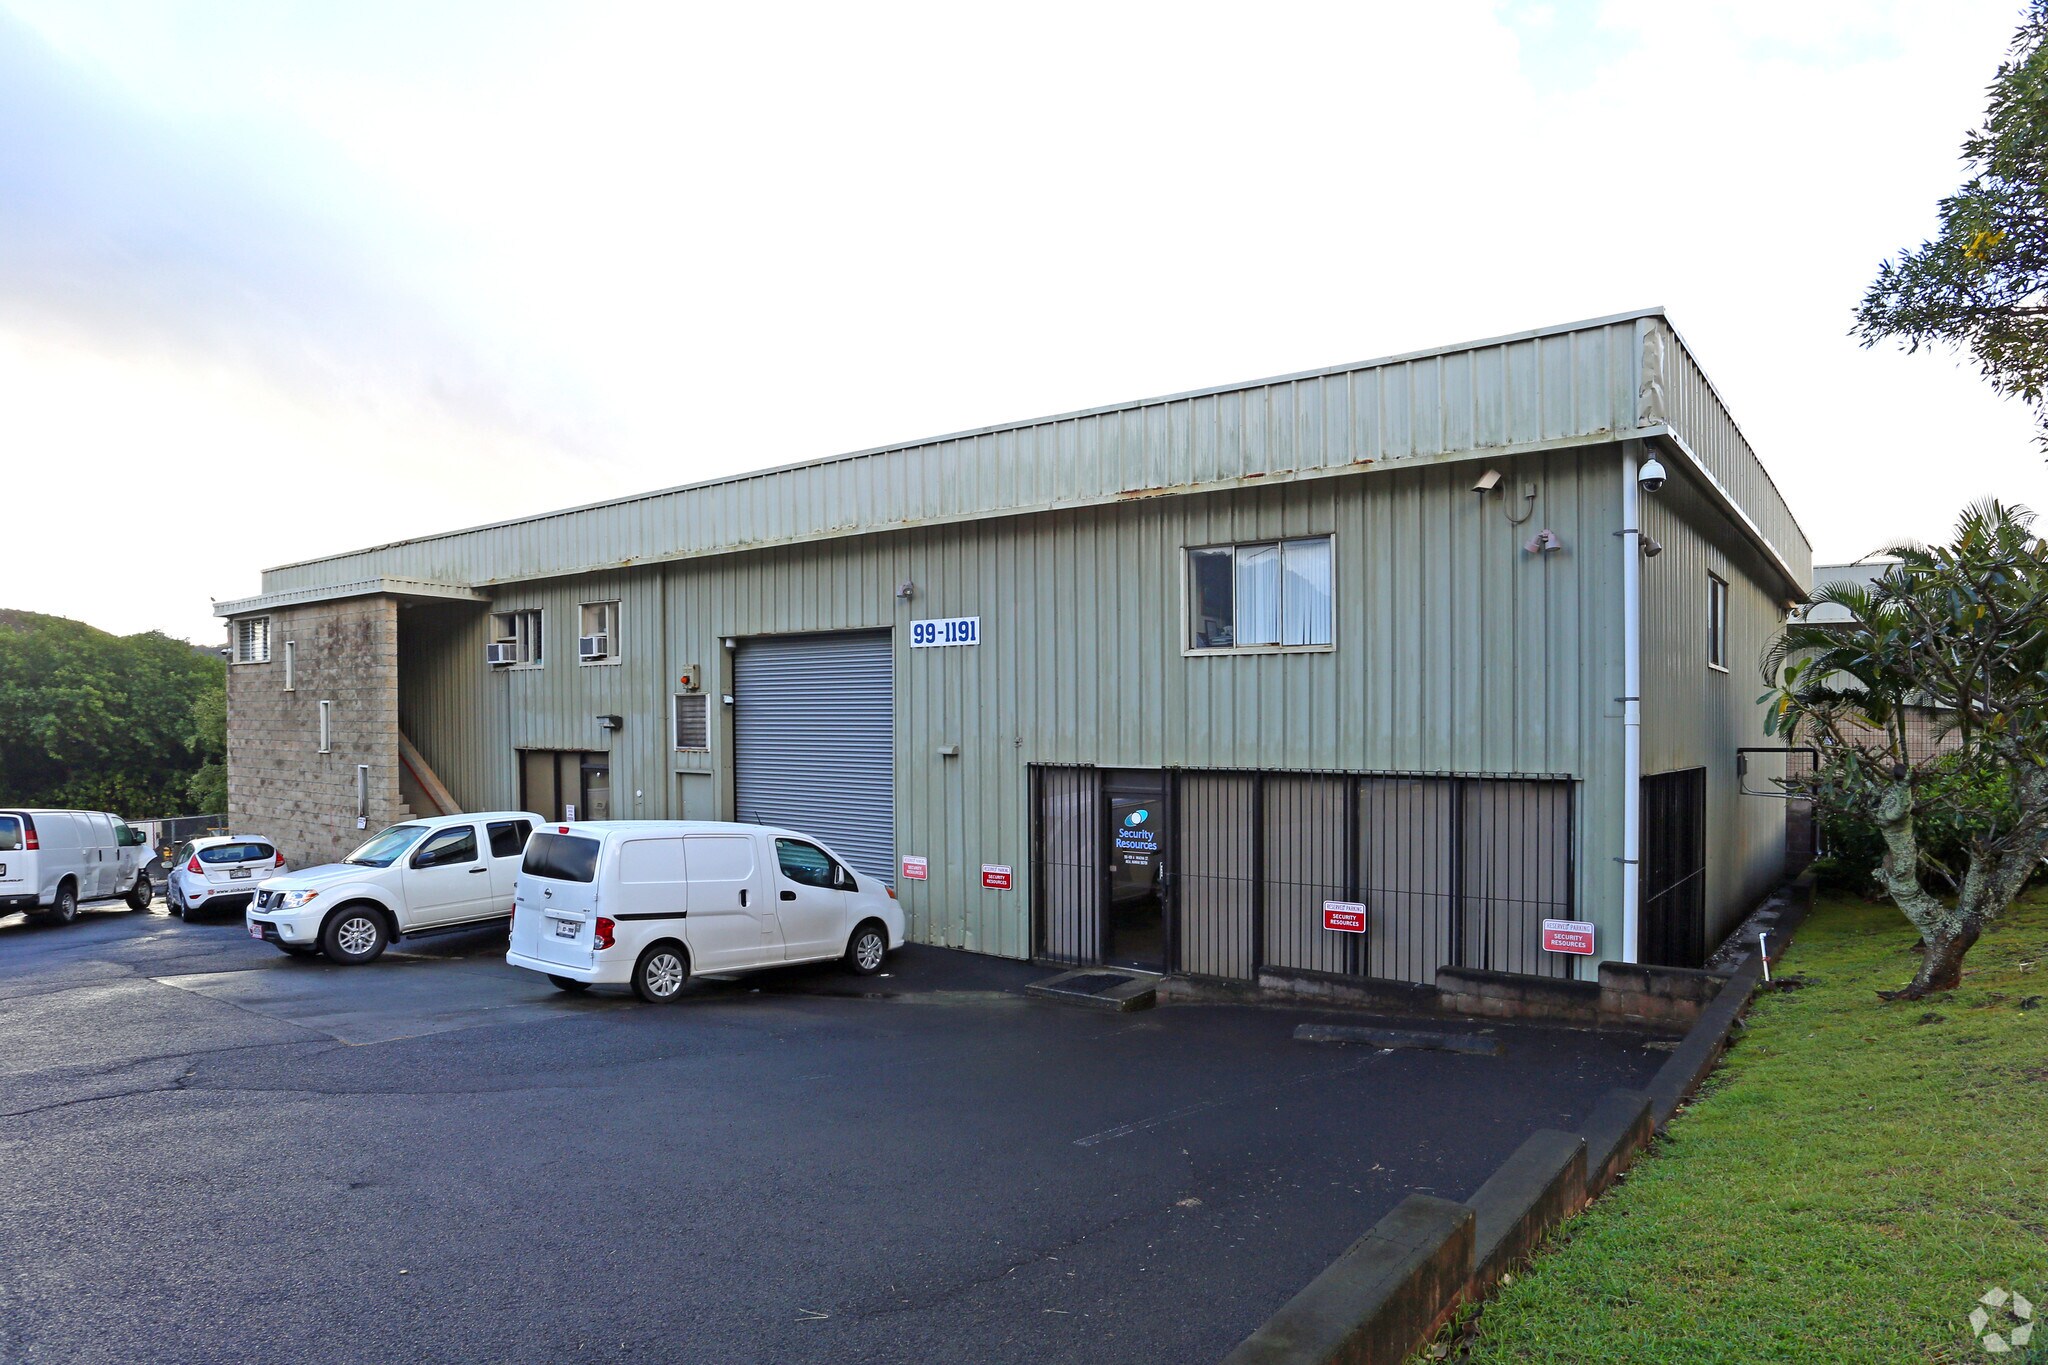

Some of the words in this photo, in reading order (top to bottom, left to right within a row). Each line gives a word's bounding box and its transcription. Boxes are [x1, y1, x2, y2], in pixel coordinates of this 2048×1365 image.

[913, 620, 976, 644] 99-1191
[1118, 828, 1154, 842] Security
[1115, 838, 1158, 851] Resources
[1332, 913, 1357, 921] SECURITY
[1330, 918, 1360, 927] RESOURCES
[1546, 922, 1569, 931] RESERVED
[1570, 924, 1591, 933] PARKING
[1553, 933, 1584, 941] SECURITY
[1550, 939, 1587, 948] RESOURCES
